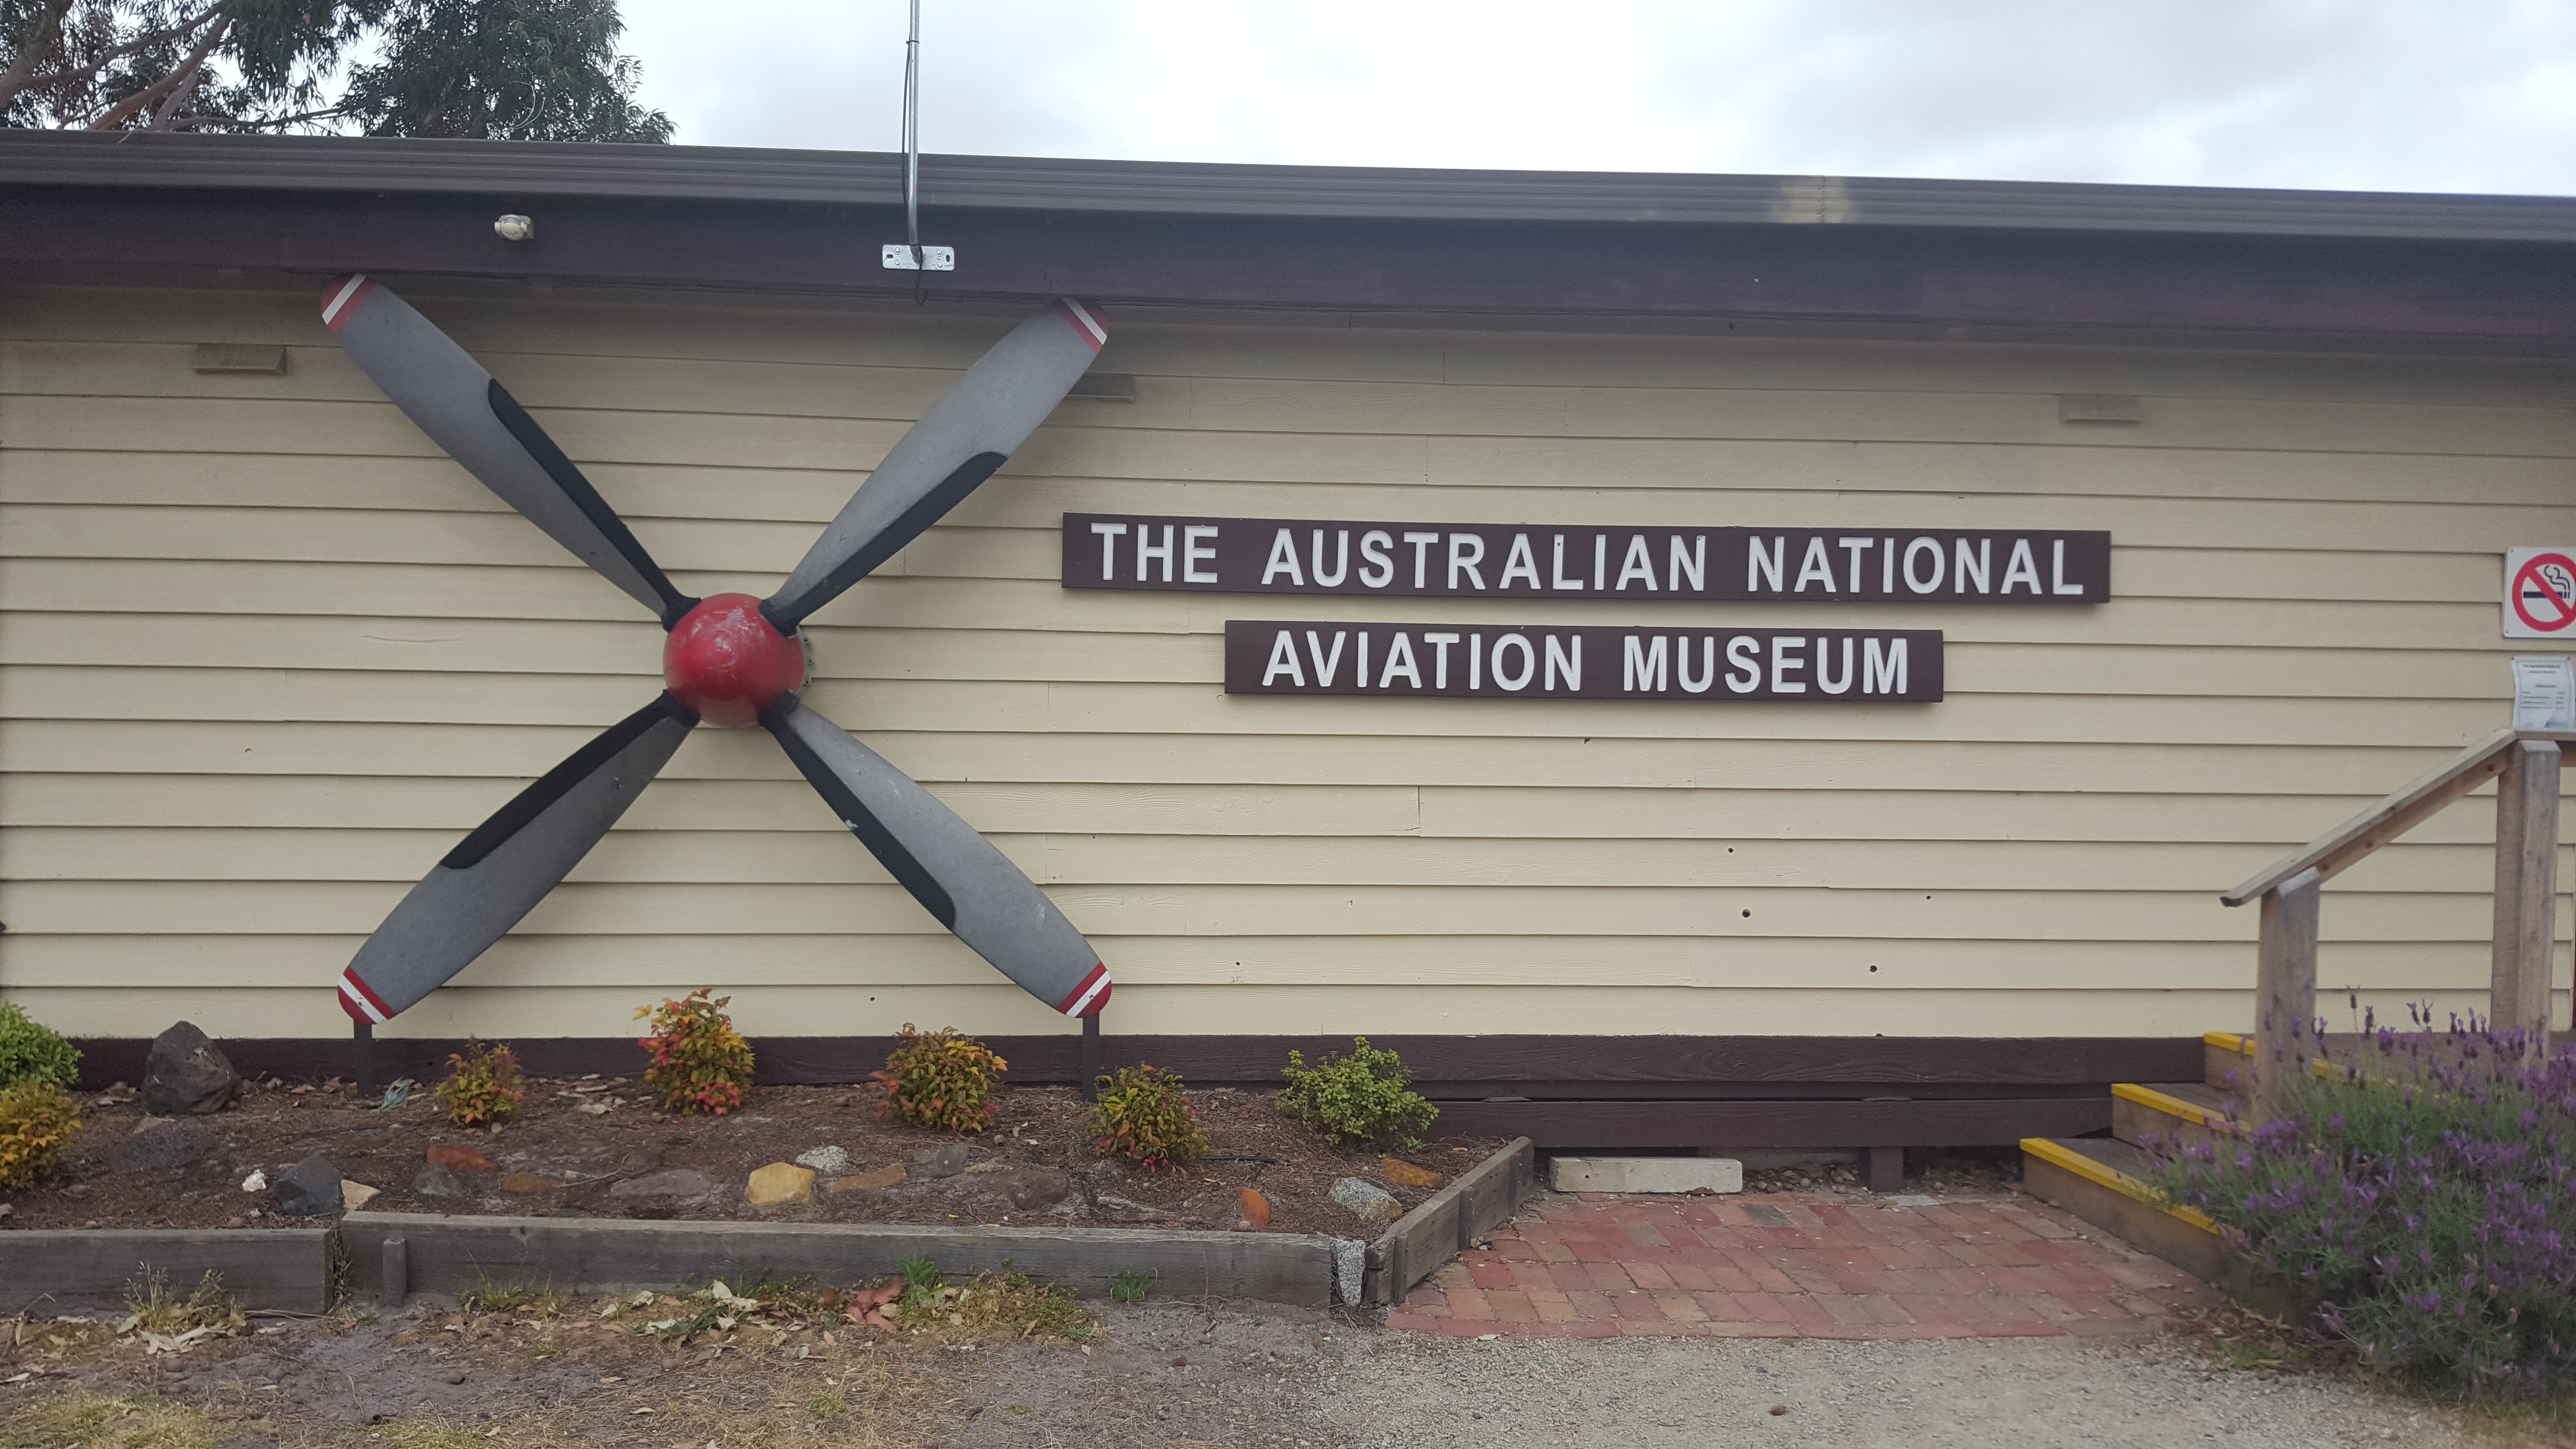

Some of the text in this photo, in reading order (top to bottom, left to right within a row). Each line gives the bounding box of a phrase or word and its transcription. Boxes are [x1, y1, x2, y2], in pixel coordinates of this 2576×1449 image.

[1091, 522, 2084, 595] THE AUSTRALIAN NATIONAL
[1261, 629, 1908, 694] AVIATION MUSEUM
